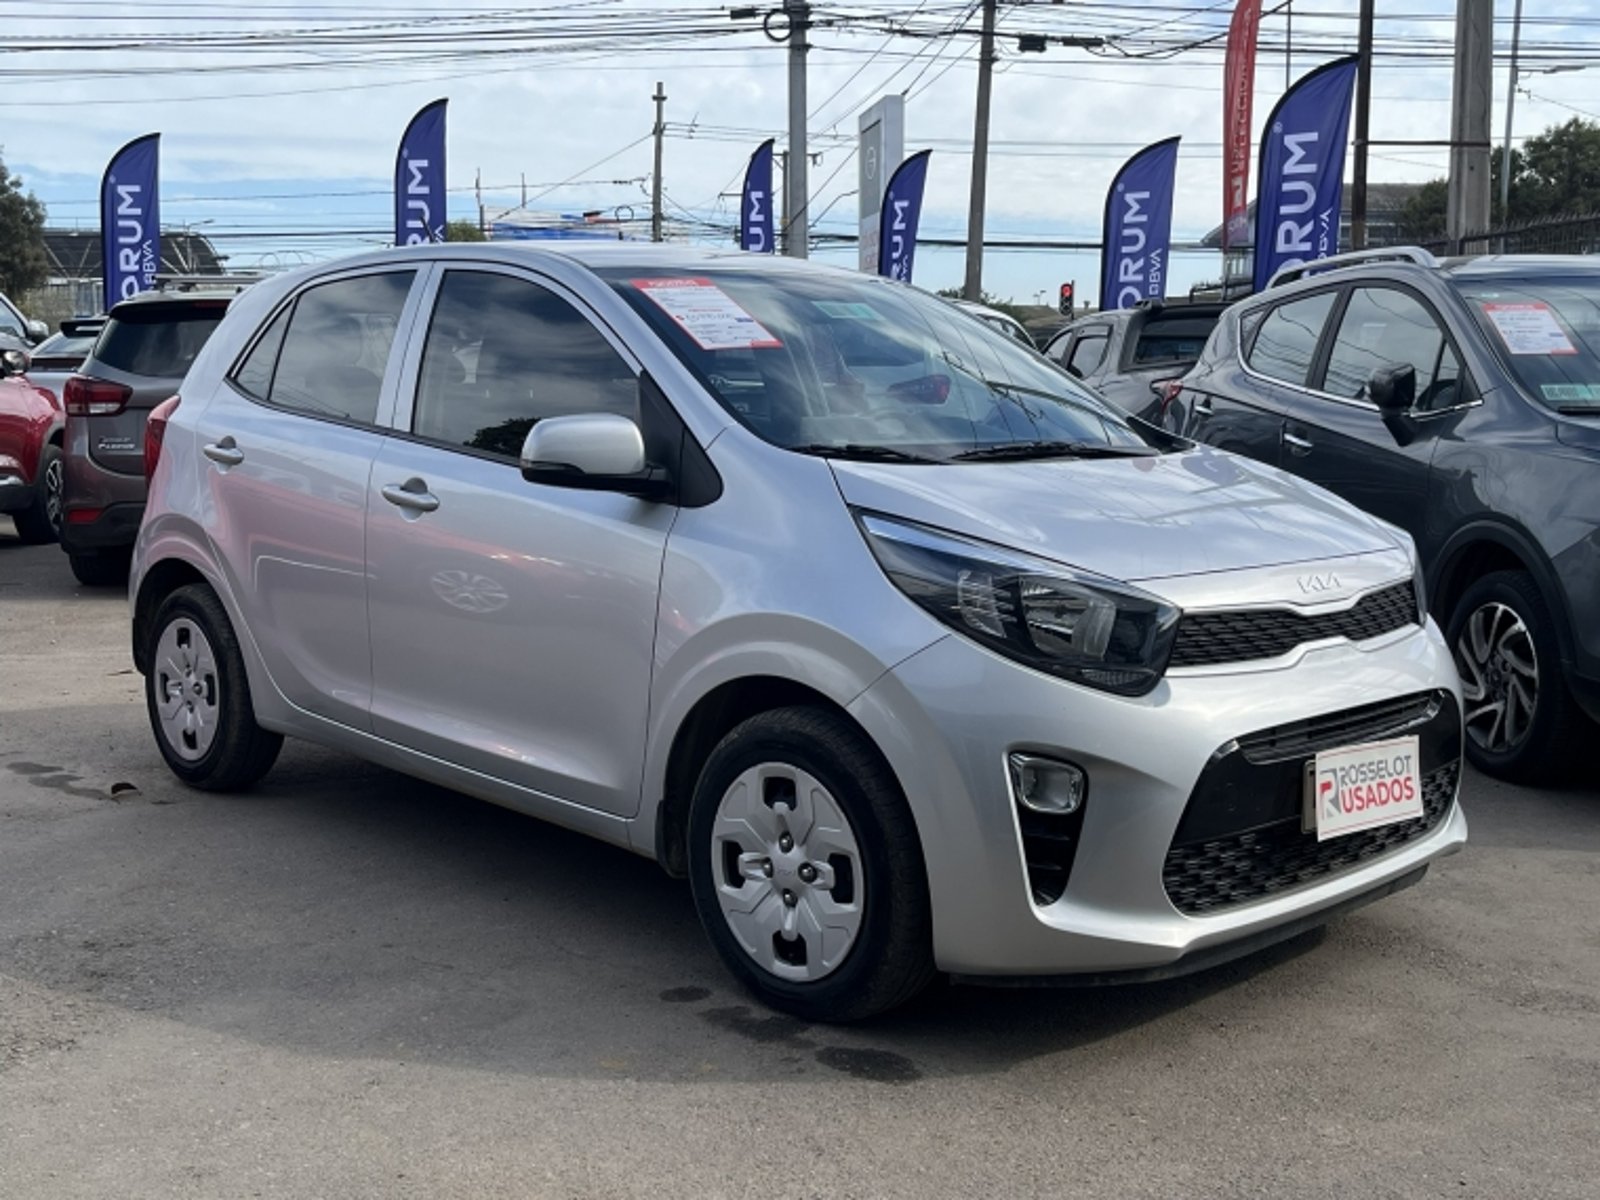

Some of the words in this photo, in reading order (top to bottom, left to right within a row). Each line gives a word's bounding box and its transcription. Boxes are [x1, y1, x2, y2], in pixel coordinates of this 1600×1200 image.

[117, 184, 142, 300] ORUM
[1117, 190, 1150, 310] ORUM
[1339, 754, 1412, 788] ROSSELOT
[1341, 776, 1415, 813] USADOS
